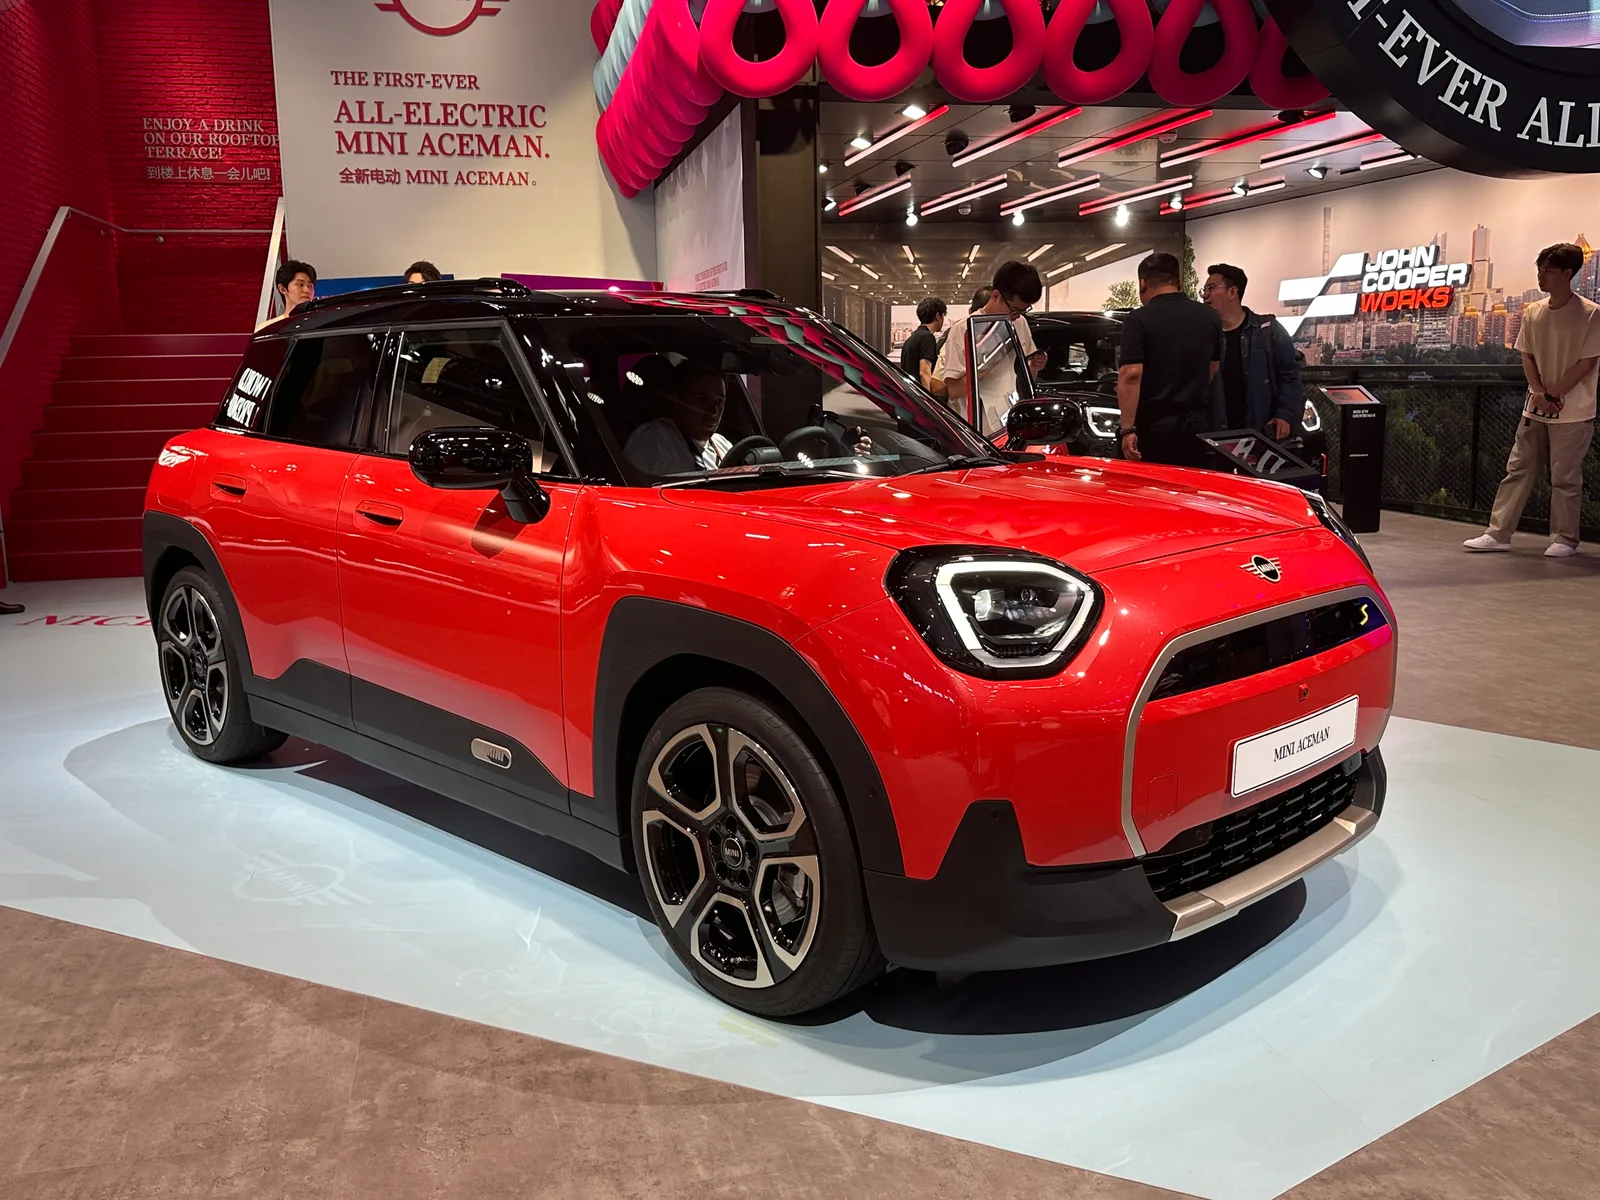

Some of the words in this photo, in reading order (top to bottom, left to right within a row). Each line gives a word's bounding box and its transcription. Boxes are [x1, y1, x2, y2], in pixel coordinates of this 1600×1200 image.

[330, 70, 369, 87] THE
[373, 71, 480, 90] FIRST-EVER
[333, 99, 547, 129] ALL-ELECTRIC
[142, 117, 192, 131] ENJOY
[198, 118, 210, 131] A
[213, 119, 264, 132] DRINK
[143, 132, 165, 145] ON
[170, 132, 203, 145] OUR
[209, 133, 280, 147] ROOFTOP
[334, 130, 409, 155] MINI
[416, 132, 550, 159] ACEMAN.
[144, 146, 222, 160] TERRACE!
[339, 167, 401, 185] 全新电动
[405, 169, 449, 185] MINI
[1365, 245, 1437, 273] JOHN
[1362, 263, 1468, 293] COOPER
[1360, 287, 1451, 313] WORKS
[15, 615, 152, 626] NIC
[1273, 741, 1296, 762] MINI
[1296, 726, 1331, 753] ACEMAN
[724, 847, 740, 858] MINI
